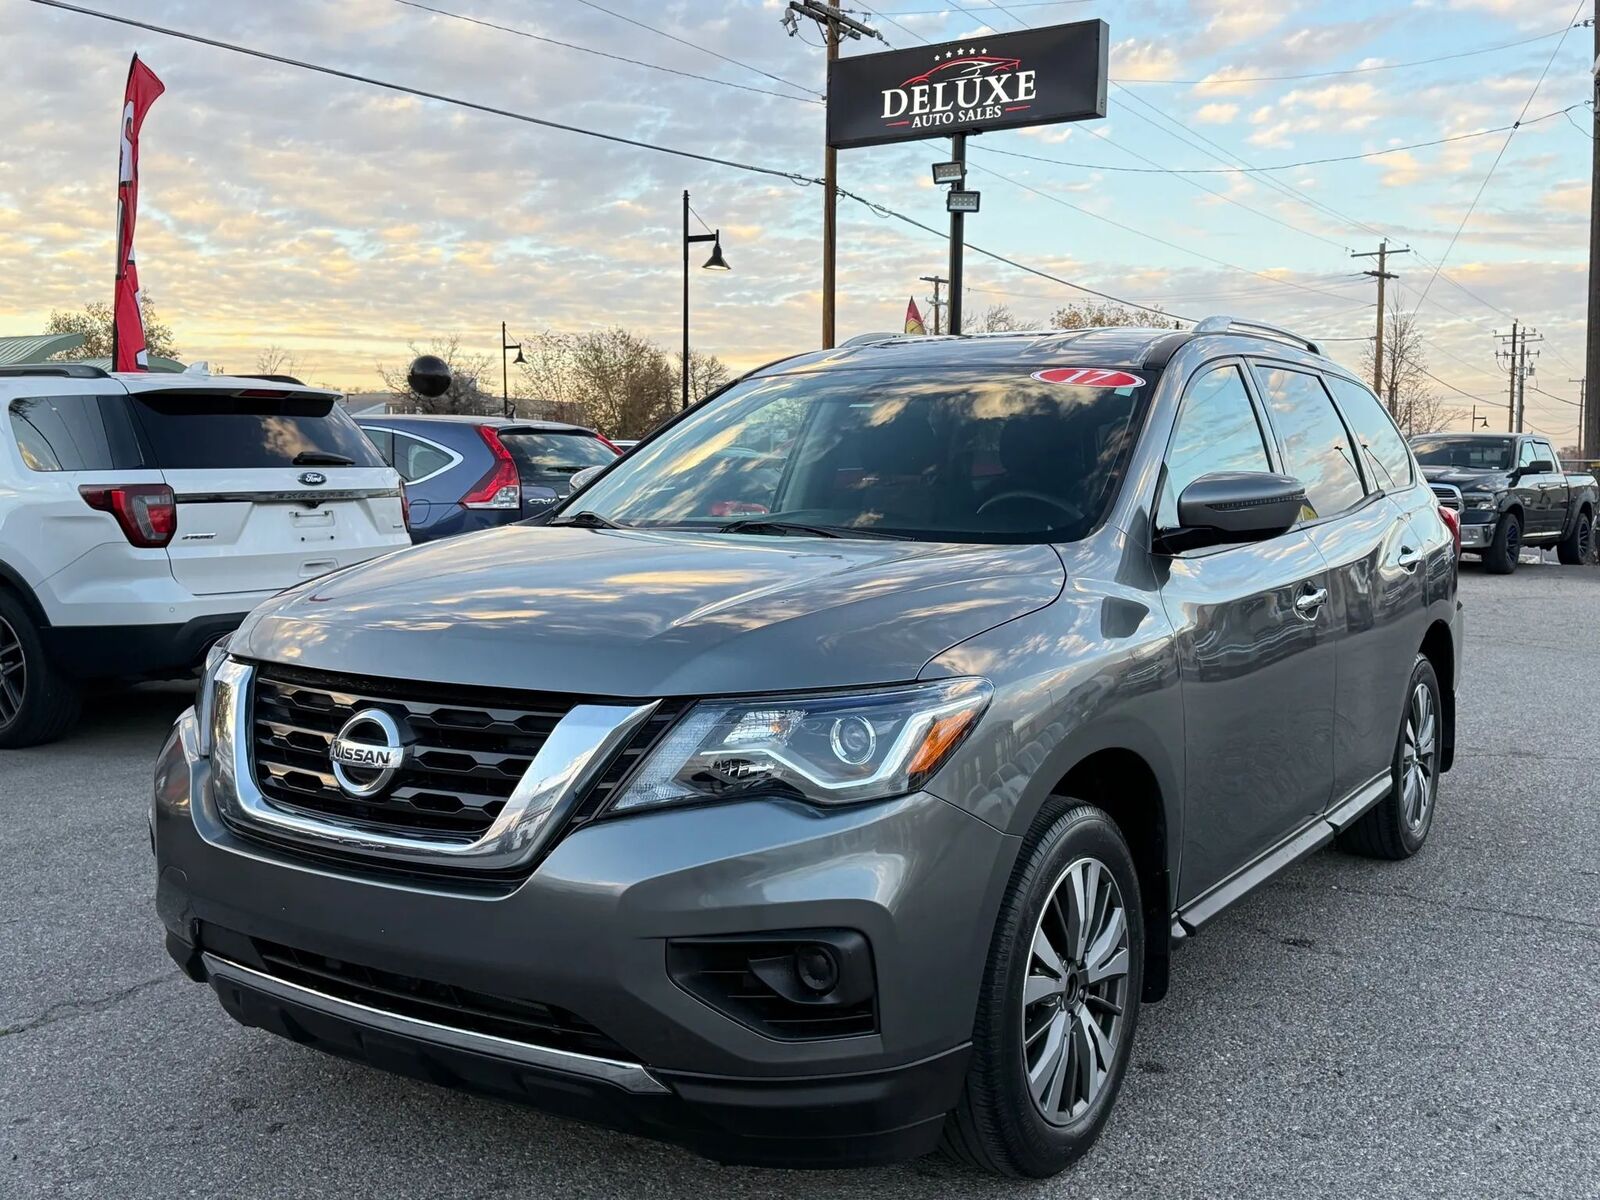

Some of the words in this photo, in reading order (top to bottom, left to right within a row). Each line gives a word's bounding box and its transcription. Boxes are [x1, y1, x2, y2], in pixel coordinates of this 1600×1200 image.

[881, 70, 1036, 119] DELUXE
[911, 111, 954, 129] AUTO
[958, 105, 1002, 122] SALES
[1061, 370, 1117, 384] 17
[332, 742, 391, 764] NISSAN
